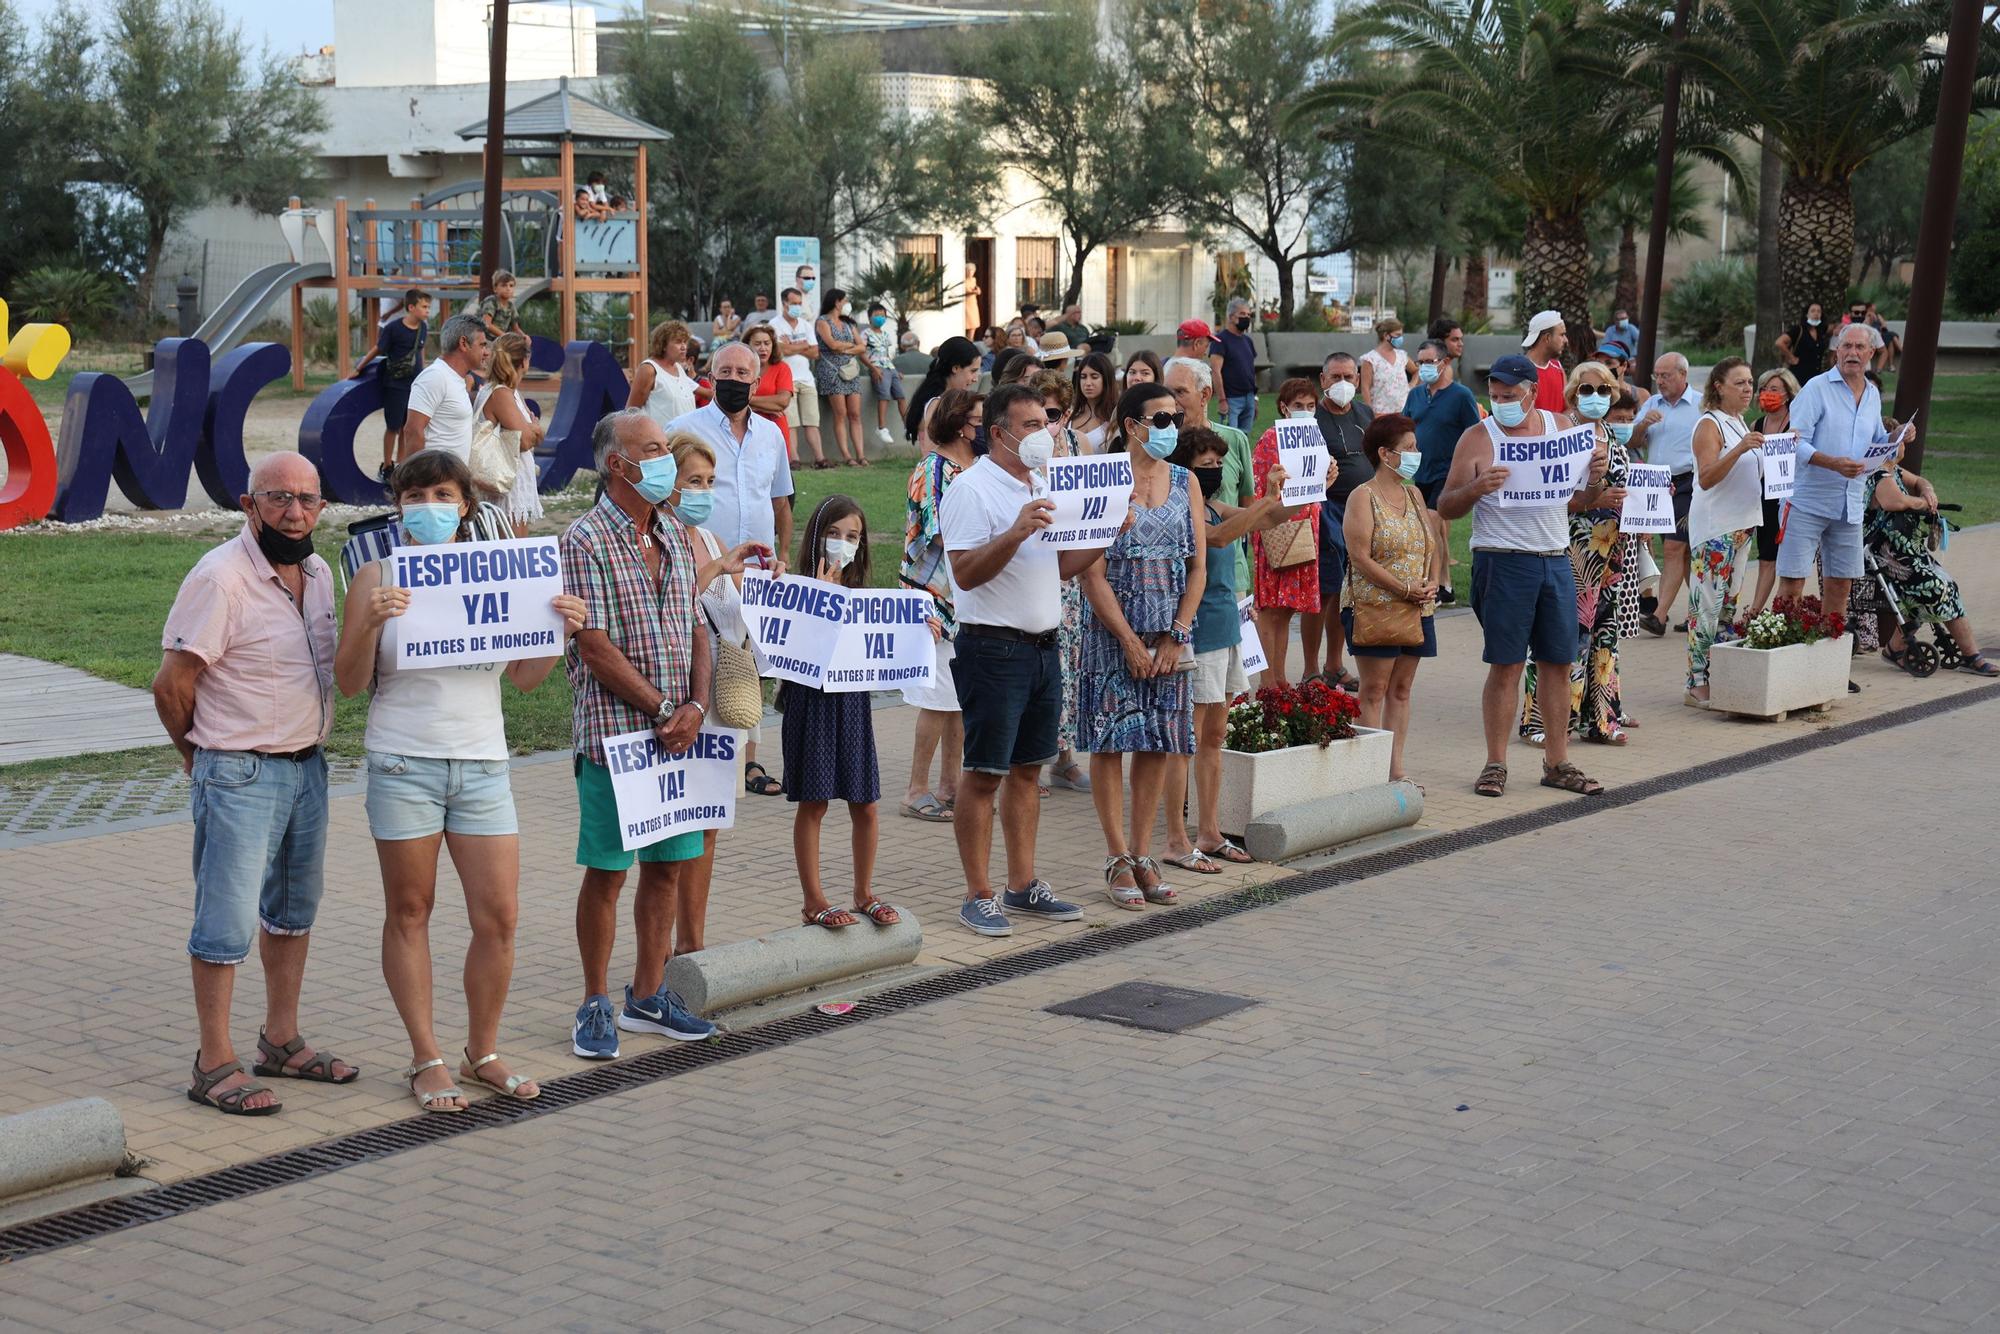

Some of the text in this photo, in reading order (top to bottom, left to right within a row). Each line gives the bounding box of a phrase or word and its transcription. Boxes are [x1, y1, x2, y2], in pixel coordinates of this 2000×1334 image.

[1500, 429, 1594, 462] ¡ESPIGONES
[1050, 460, 1132, 492] ¡ESPIGONES
[1302, 455, 1317, 477] YA!
[1541, 462, 1570, 484] YA!
[1627, 468, 1671, 488] ¡ESPIGONES
[1081, 496, 1107, 520] YA!
[1503, 490, 1541, 500] PLATGES
[1545, 490, 1556, 499] DE
[1646, 493, 1659, 512] YA!
[1624, 516, 1644, 526] PLATGES
[1645, 517, 1652, 526] DE
[1041, 531, 1076, 543] PLATGES
[1078, 529, 1087, 541] DE
[398, 545, 558, 589] ¡ESPIGONES
[462, 591, 509, 626] YA!
[743, 576, 846, 623] ¡ESPIGONES
[406, 630, 555, 657] PLATGES DE MONCOFA
[759, 615, 792, 646] YA!
[864, 632, 894, 660] YA!
[827, 665, 929, 683] PLATGES DE MONCOFA
[658, 769, 685, 803] YA!
[627, 805, 726, 838] PLATGES DE MONCOFA
